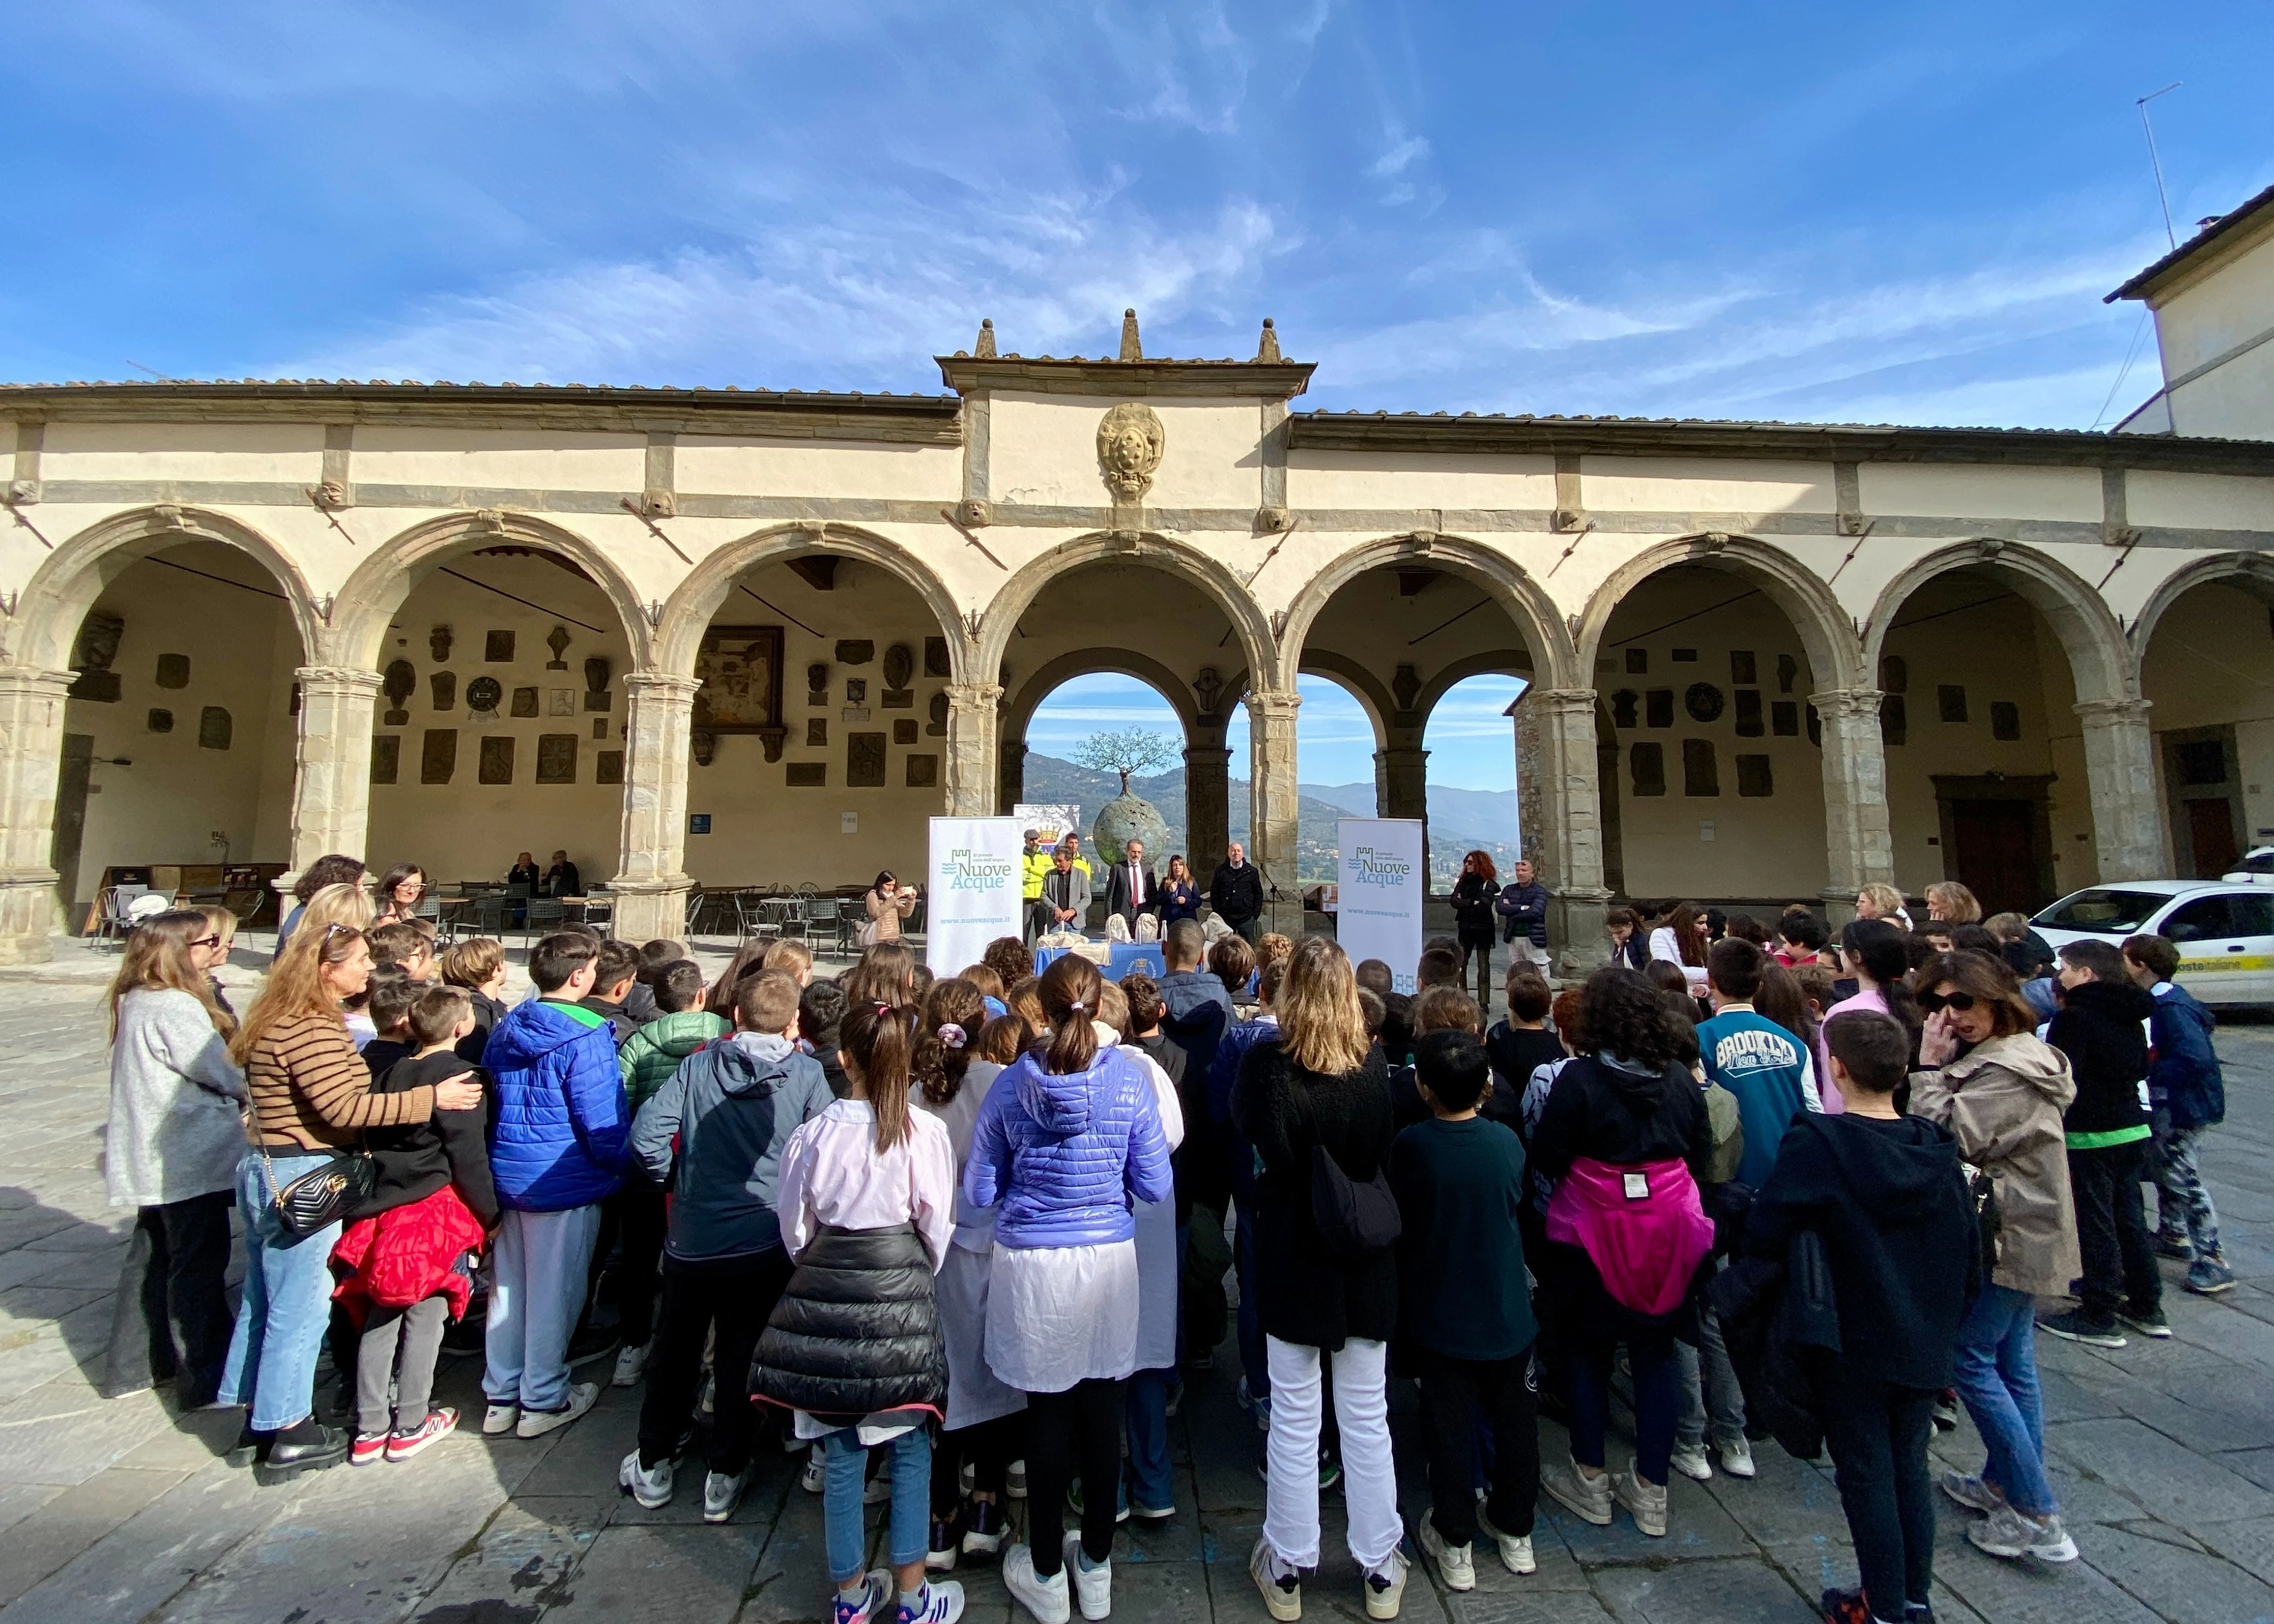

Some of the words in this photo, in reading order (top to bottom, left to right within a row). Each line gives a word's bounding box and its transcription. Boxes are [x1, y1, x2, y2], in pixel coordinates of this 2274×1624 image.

[958, 863, 1011, 878] Nuove
[1362, 859, 1410, 875] Nuove
[950, 874, 1005, 893] Acque
[1355, 869, 1404, 888] Acque
[940, 916, 1011, 925] www.nuoveacque.it
[1347, 908, 1410, 918] www.nuoveacque.it
[2178, 958, 2241, 971] osteitaliane
